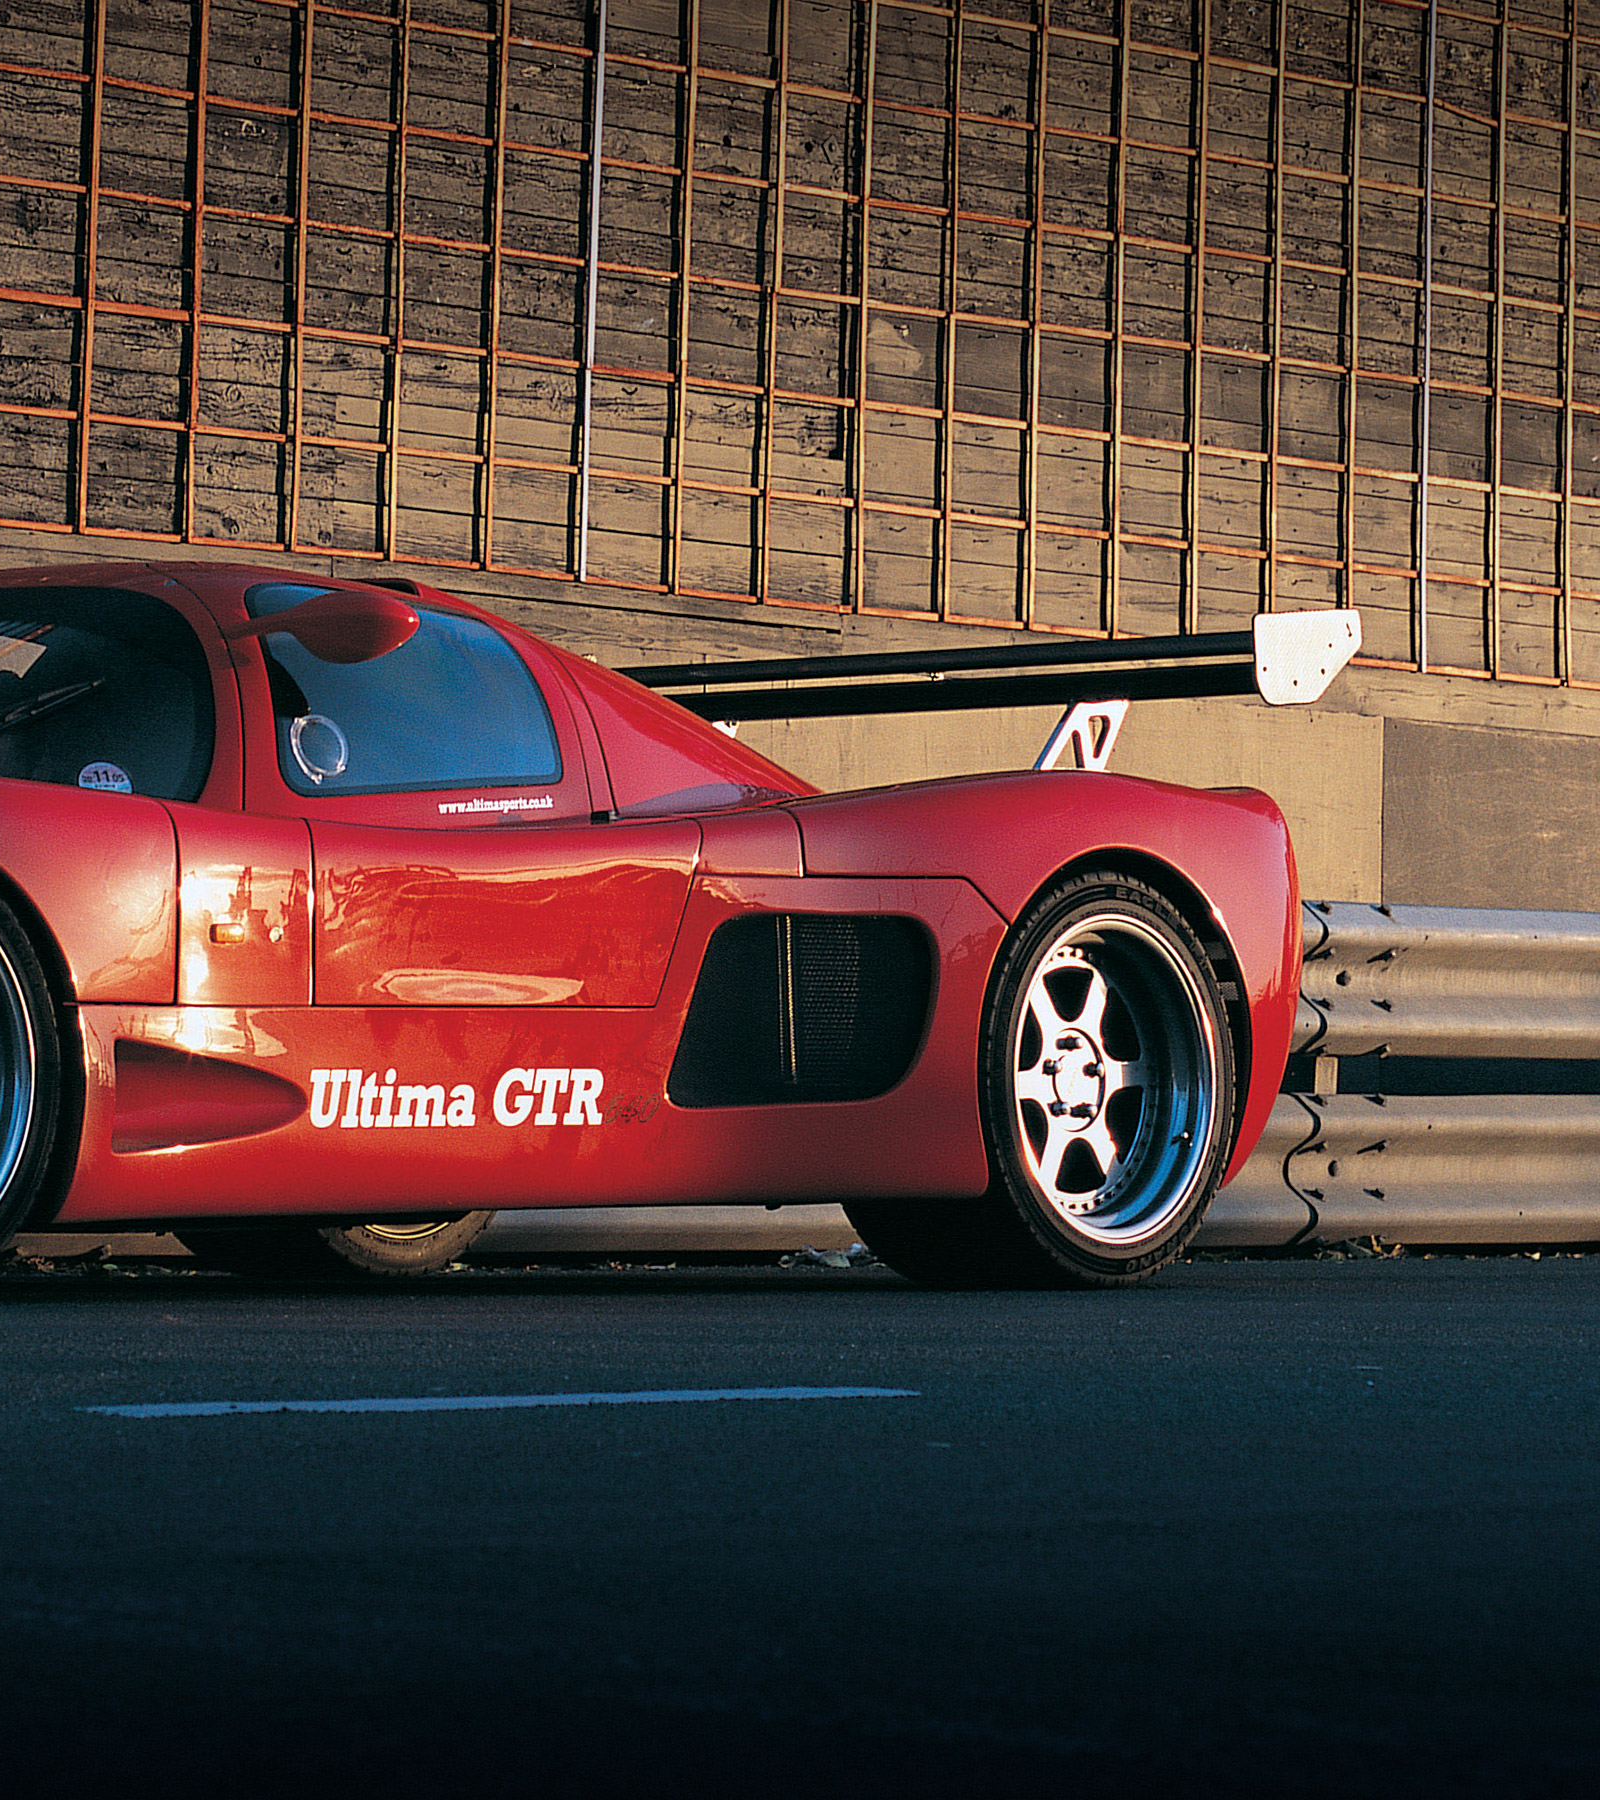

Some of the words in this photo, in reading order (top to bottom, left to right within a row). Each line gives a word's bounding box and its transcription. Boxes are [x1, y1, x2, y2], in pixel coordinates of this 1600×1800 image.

[93, 770, 111, 783] 11
[309, 1068, 476, 1129] Ultima
[493, 1067, 604, 1127] GTR
